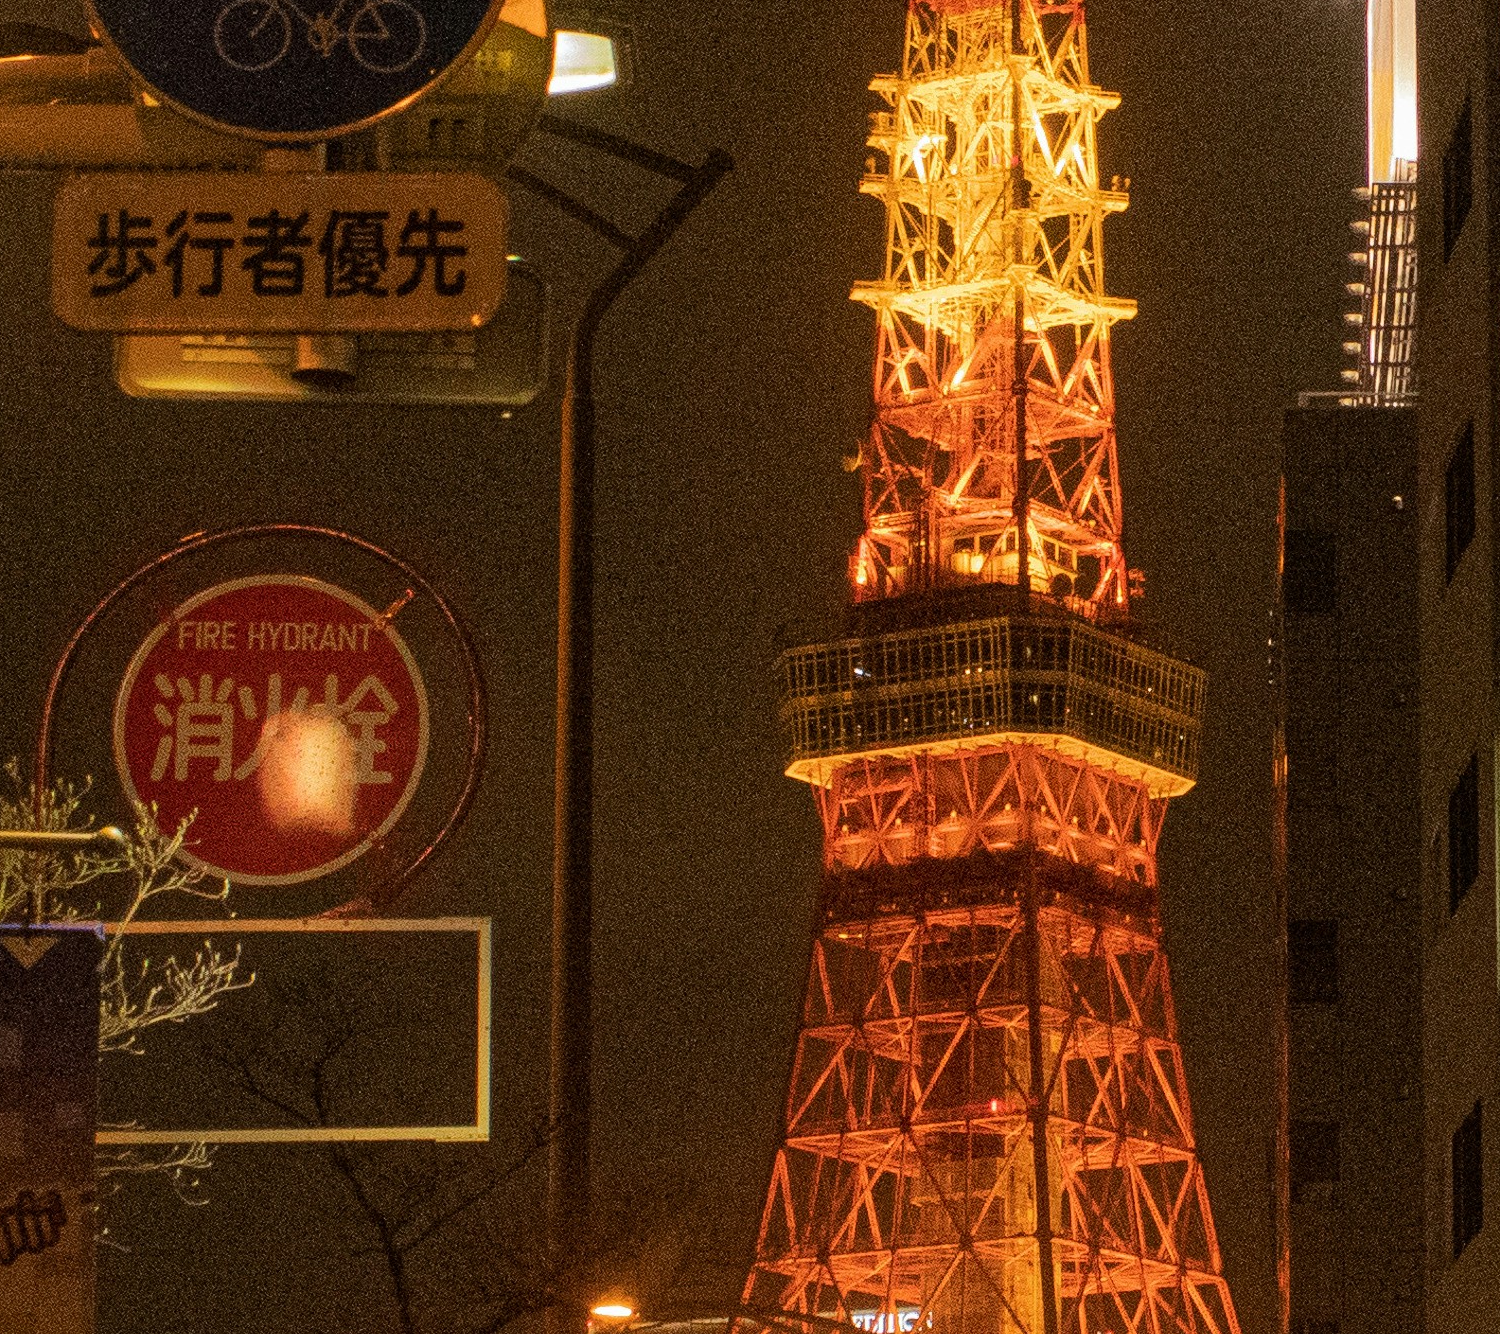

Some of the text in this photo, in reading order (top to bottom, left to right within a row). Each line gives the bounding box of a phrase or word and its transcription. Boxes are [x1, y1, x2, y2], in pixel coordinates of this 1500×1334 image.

[86, 208, 469, 298] 歩行者優先
[178, 621, 374, 652] FIRE HYDRANT
[150, 673, 400, 784] 消火栓
